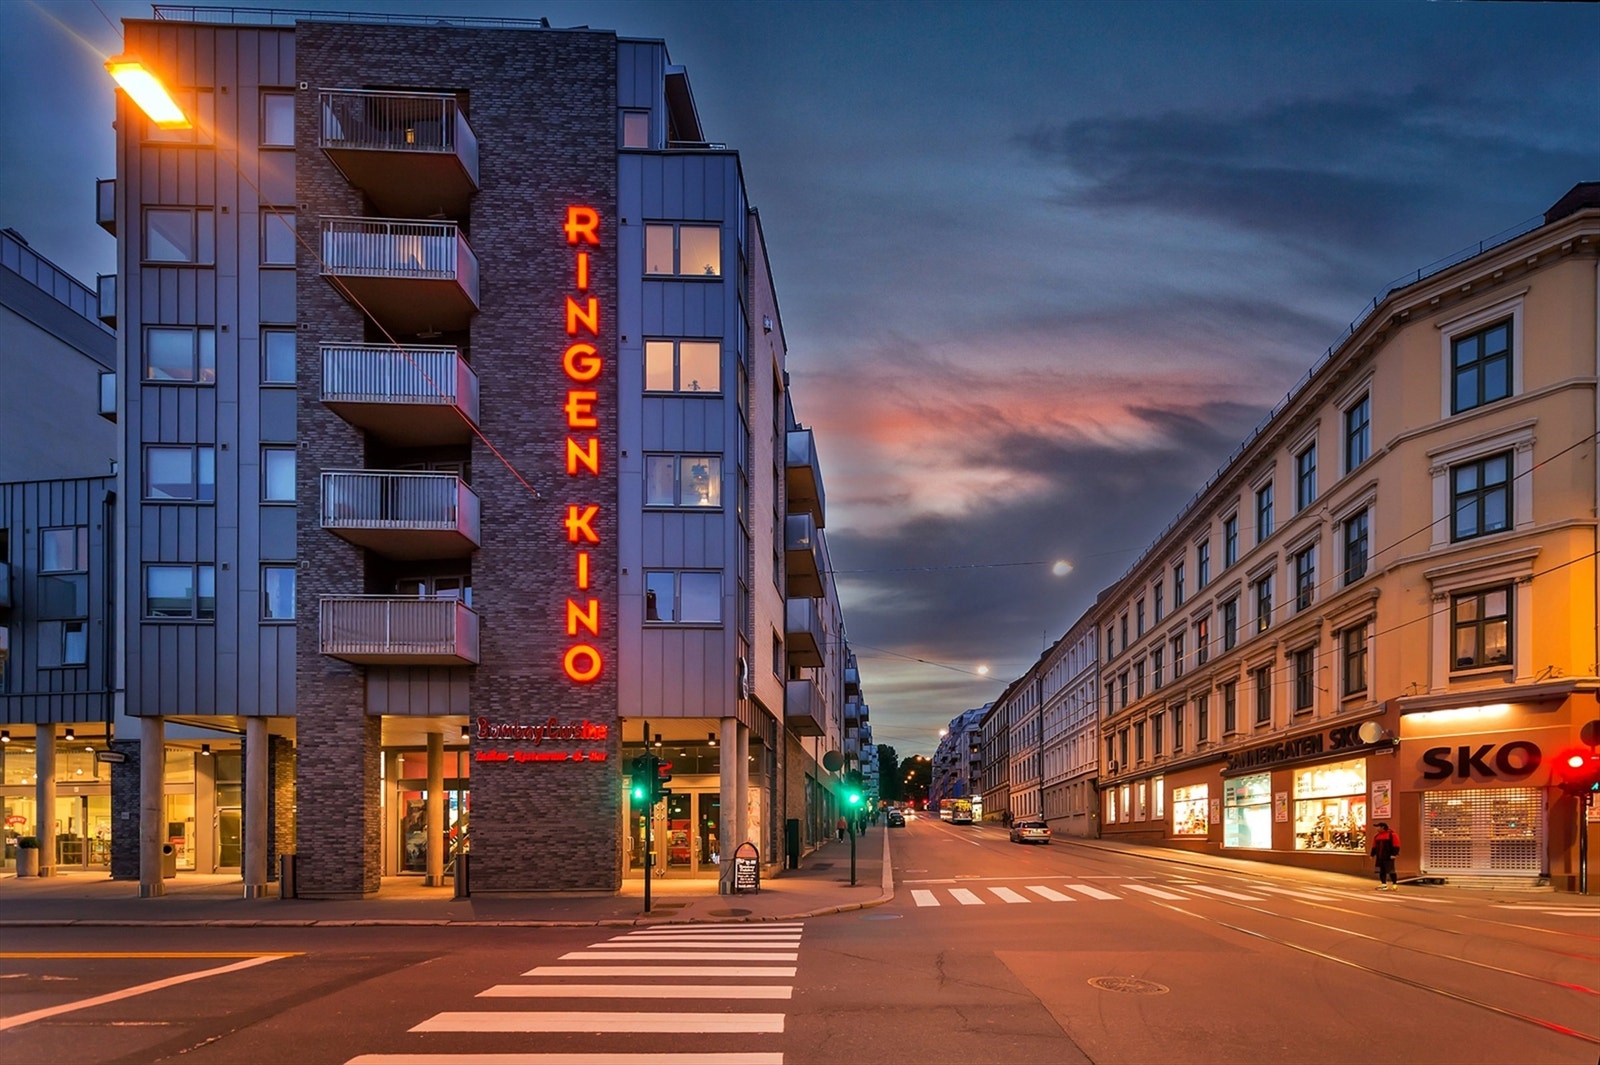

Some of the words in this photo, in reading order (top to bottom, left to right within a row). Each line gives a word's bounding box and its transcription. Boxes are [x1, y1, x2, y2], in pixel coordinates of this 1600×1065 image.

[563, 205, 602, 476] RINGEN
[563, 504, 602, 683] KINO
[477, 717, 544, 744] Bombay
[547, 717, 608, 740] Cuisine
[1227, 733, 1323, 770] SANNERGATEN
[1422, 740, 1543, 780] SKO
